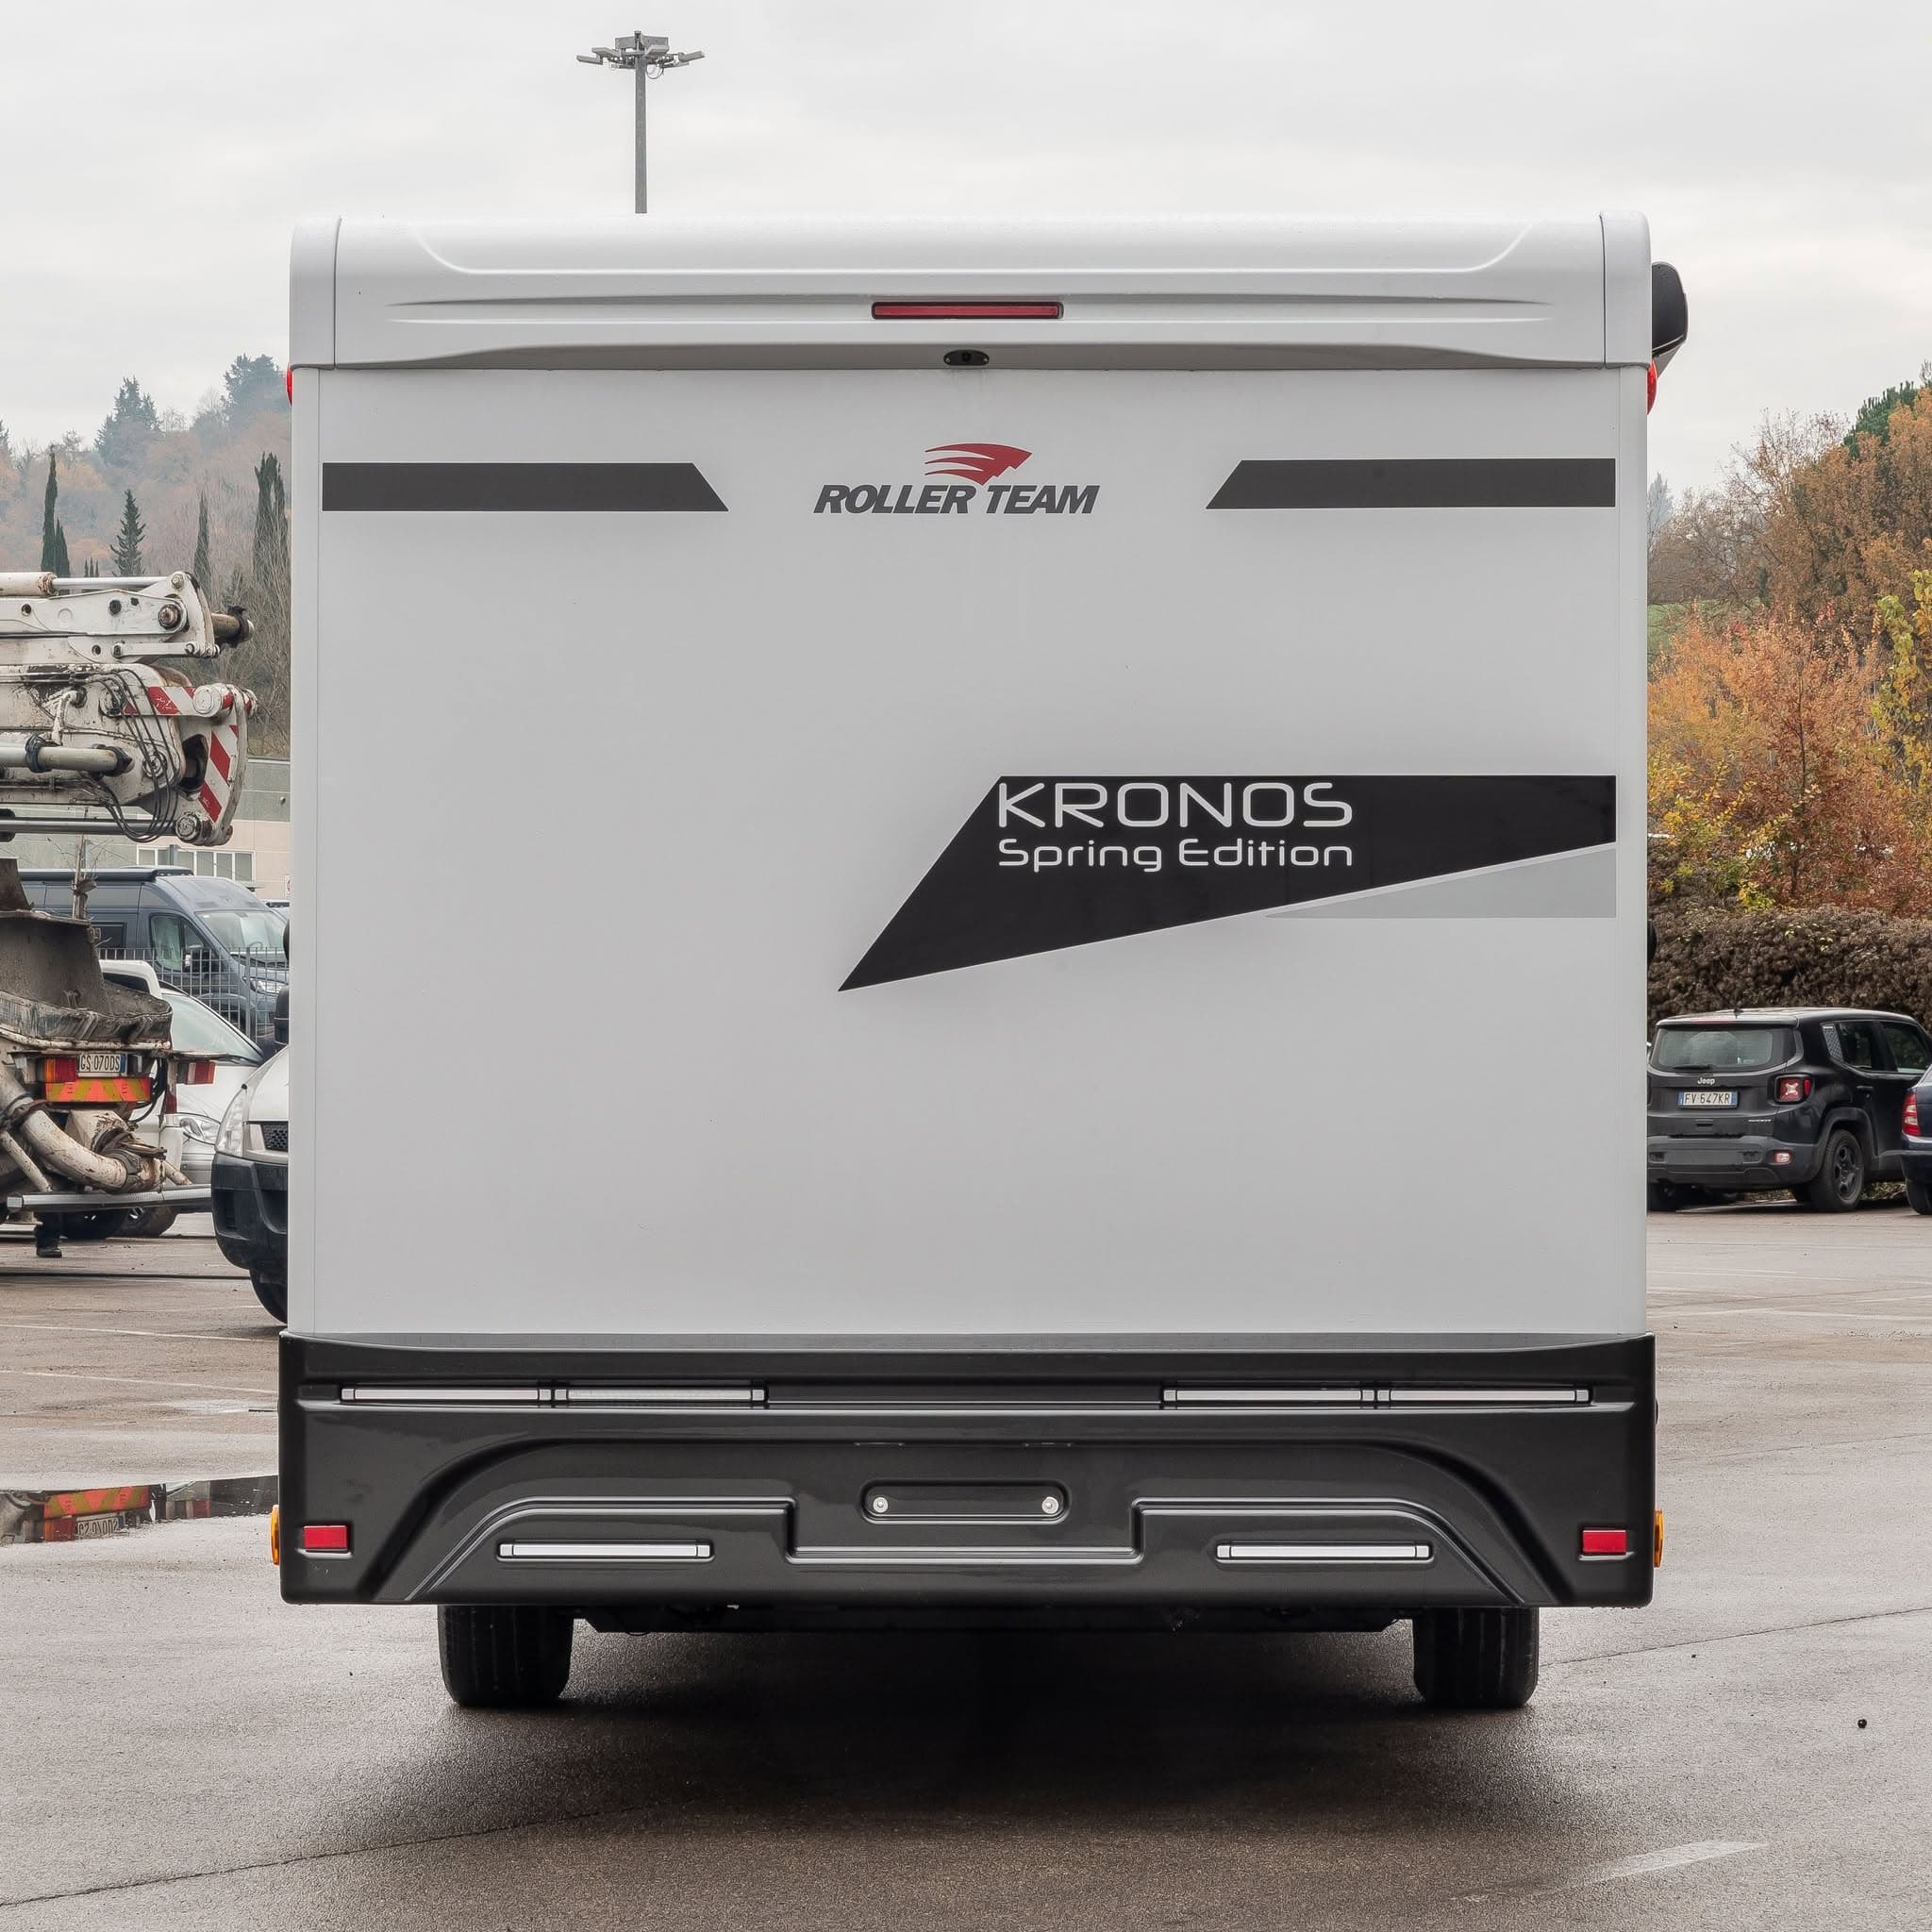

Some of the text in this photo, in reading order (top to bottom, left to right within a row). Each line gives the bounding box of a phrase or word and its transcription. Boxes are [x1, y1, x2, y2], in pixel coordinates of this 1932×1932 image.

[813, 484, 1101, 514] ROLLER TEAM
[998, 782, 1353, 828] KRONOS
[998, 838, 1353, 873] Spring Edition
[80, 1055, 92, 1071] GS
[1685, 1093, 1730, 1104] FV 647KR
